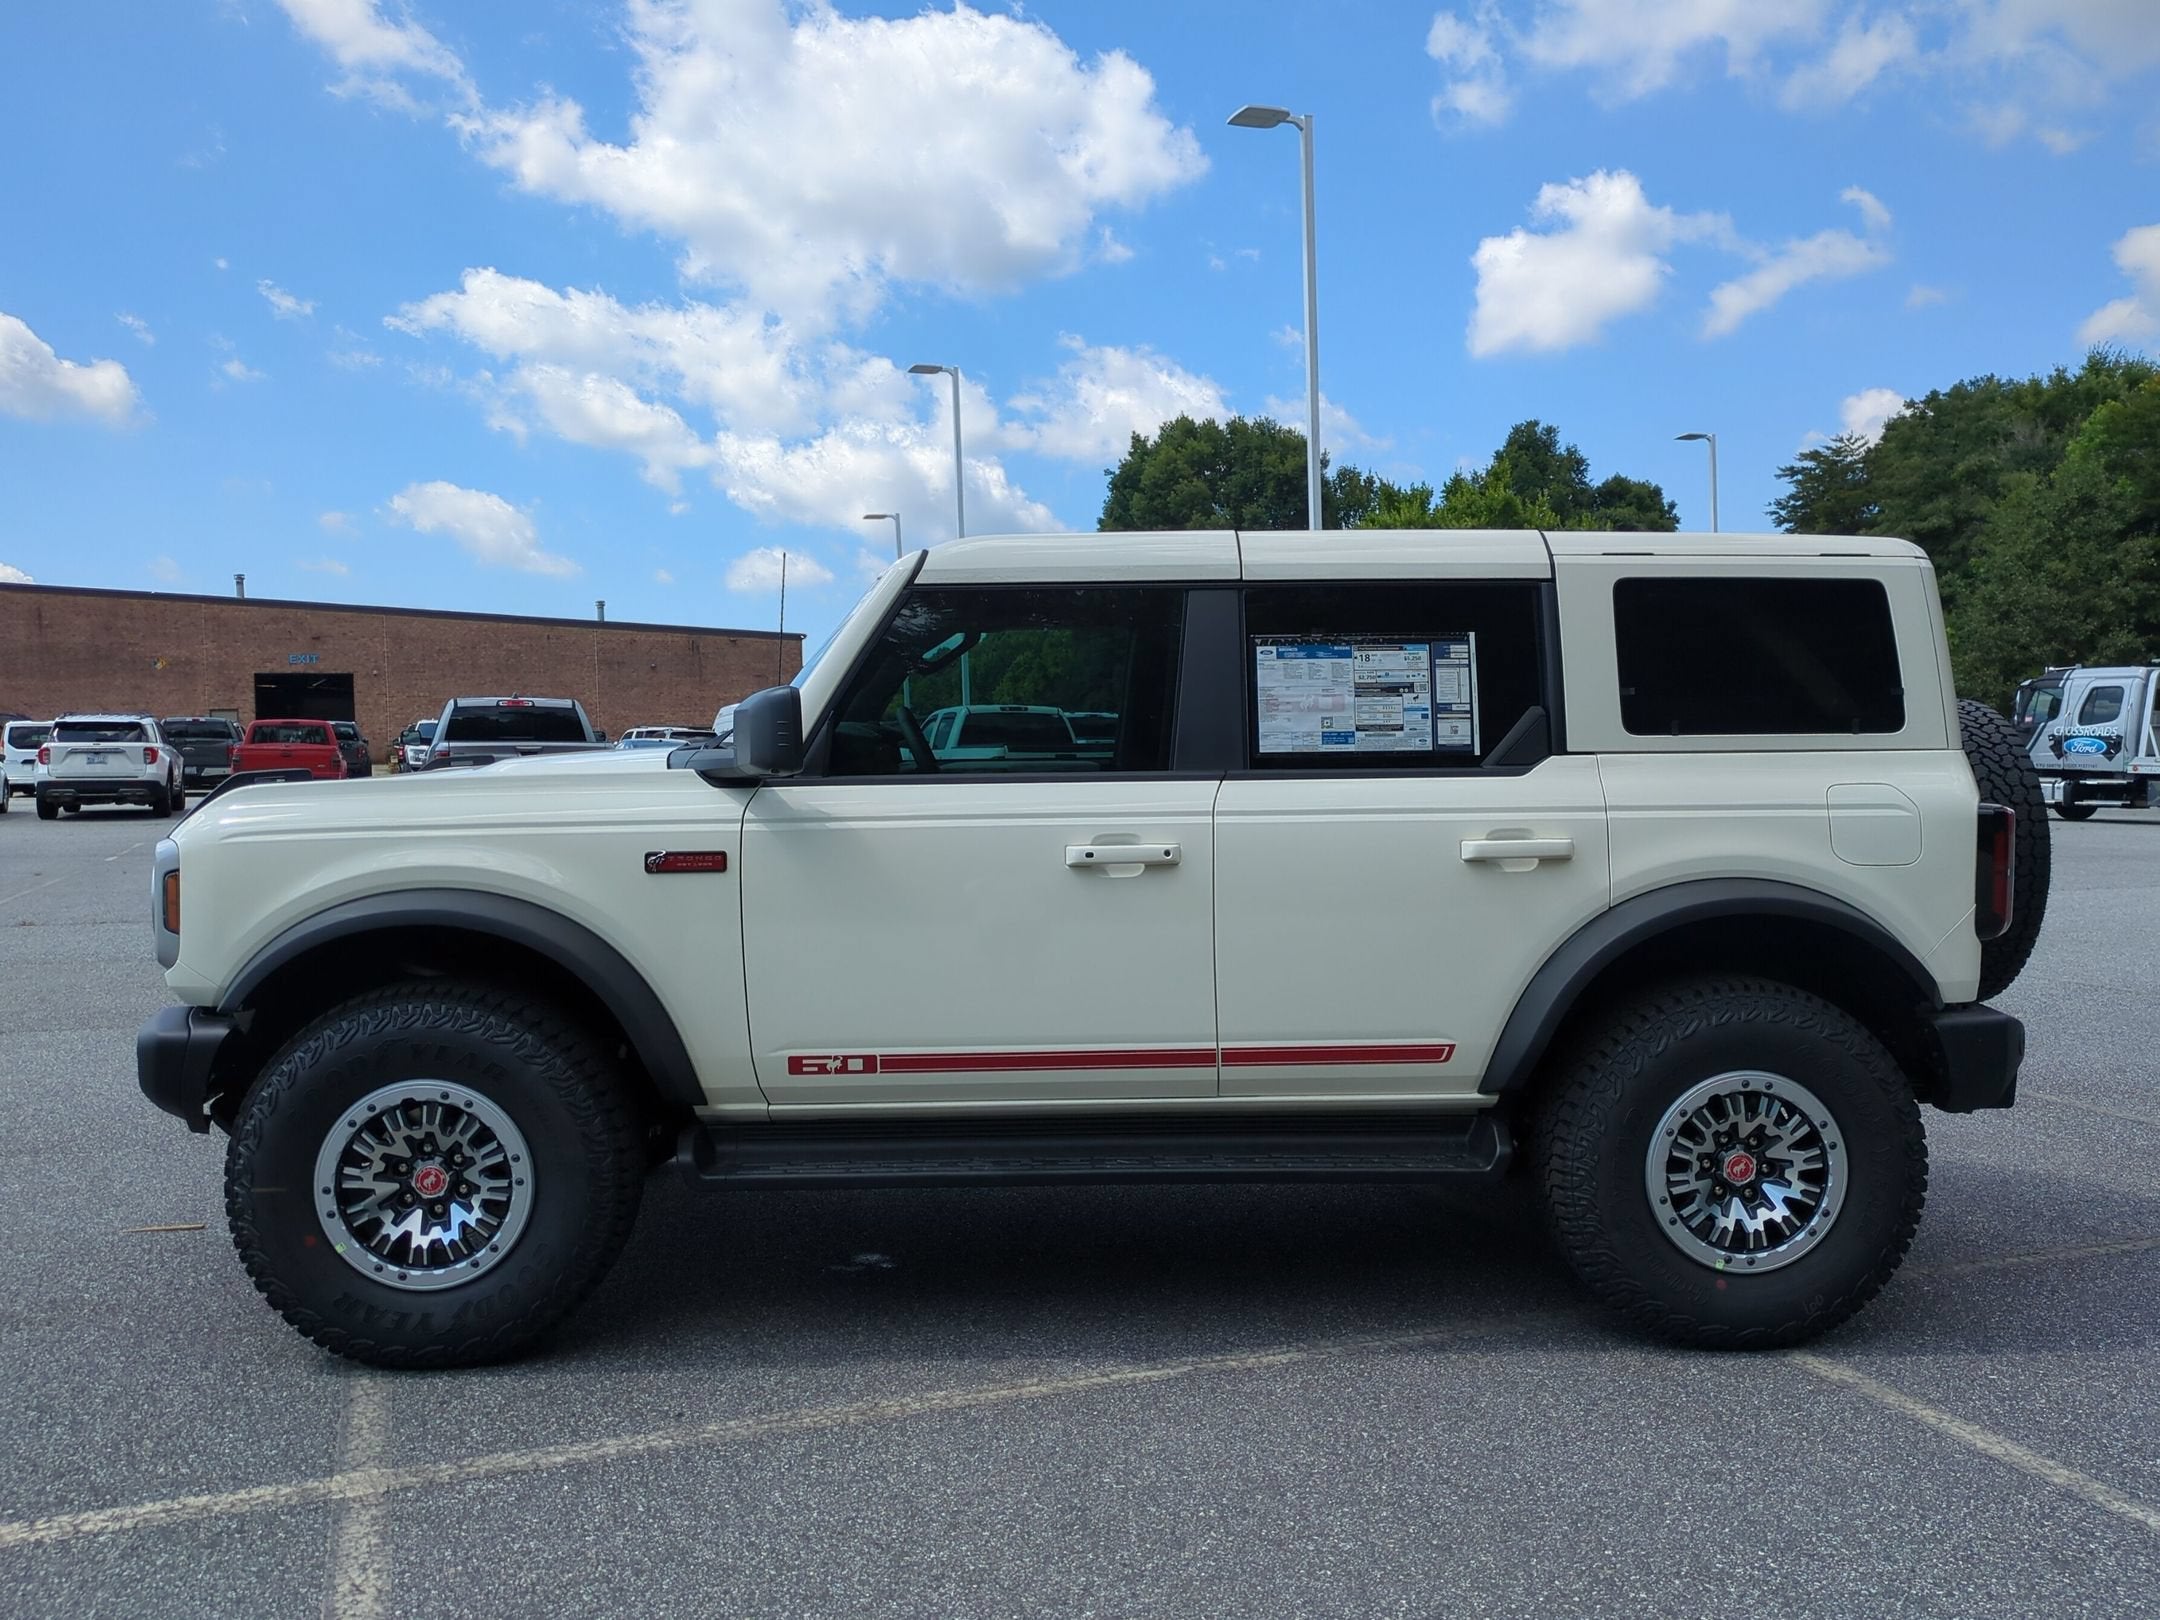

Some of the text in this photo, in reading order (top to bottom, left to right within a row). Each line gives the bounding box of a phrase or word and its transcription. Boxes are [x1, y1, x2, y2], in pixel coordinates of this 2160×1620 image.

[288, 653, 318, 664] EXIT
[1359, 653, 1370, 662] 18
[2053, 726, 2118, 736] CROSSROADS
[2071, 741, 2098, 752] Ford
